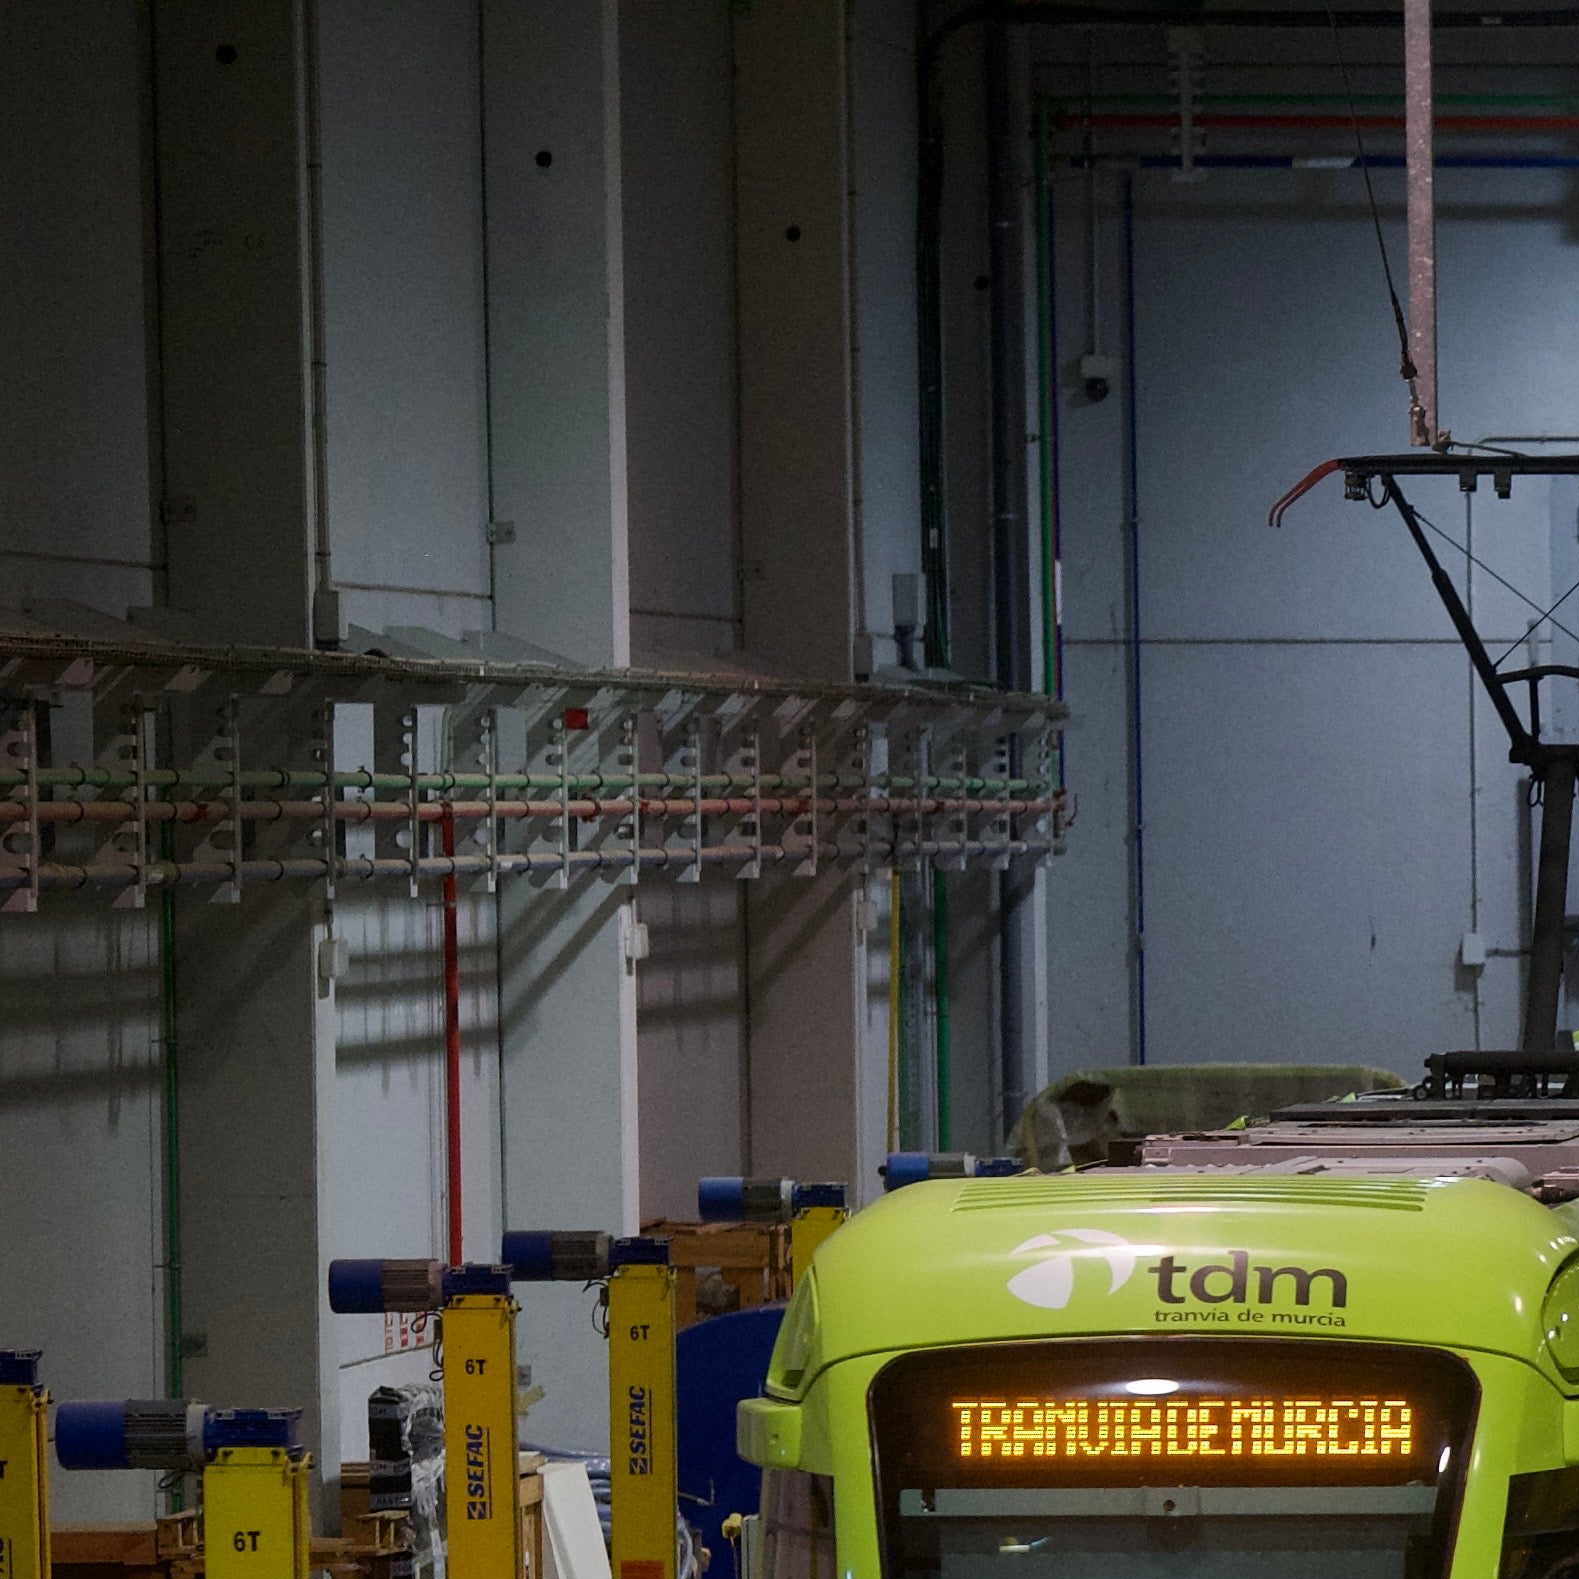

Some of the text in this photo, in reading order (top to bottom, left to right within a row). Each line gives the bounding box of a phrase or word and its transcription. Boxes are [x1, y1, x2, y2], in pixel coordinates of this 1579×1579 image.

[1148, 1250, 1348, 1308] tdm
[1154, 1307, 1347, 1327] tranvía de murcia
[629, 1325, 651, 1341] 6T
[465, 1358, 487, 1376] 6T
[629, 1385, 647, 1455] SEFAC
[467, 1425, 486, 1498] SEFAC
[232, 1530, 261, 1552] 6T
